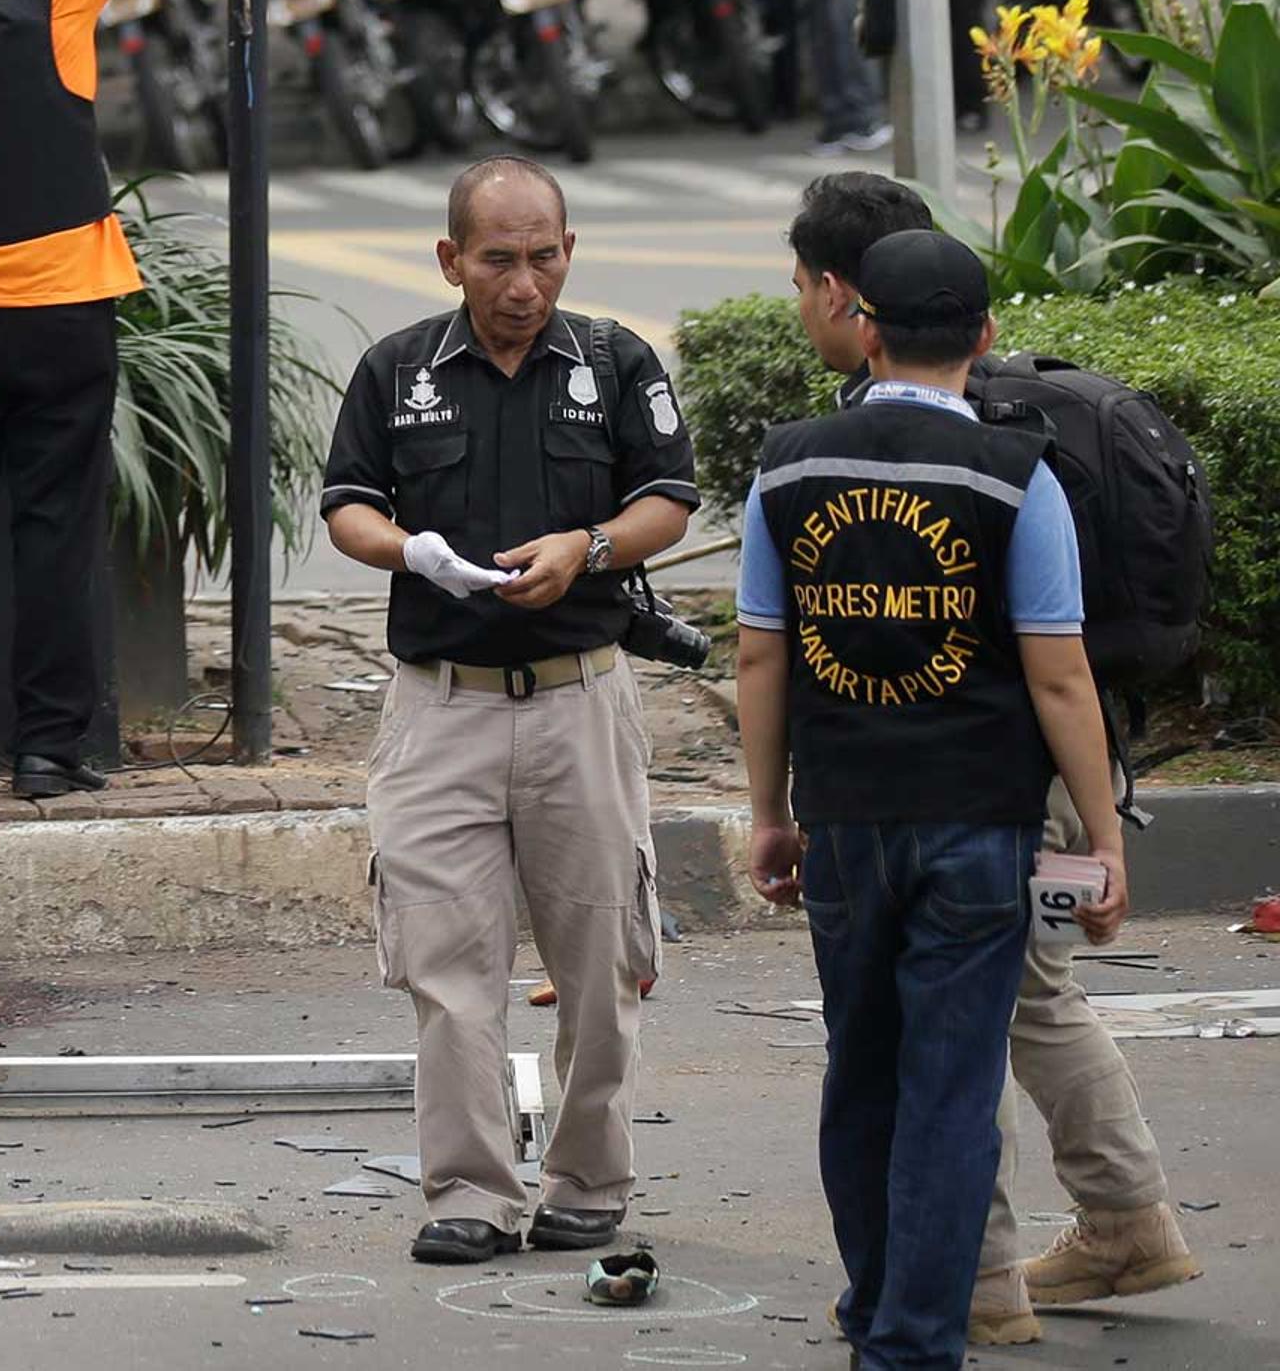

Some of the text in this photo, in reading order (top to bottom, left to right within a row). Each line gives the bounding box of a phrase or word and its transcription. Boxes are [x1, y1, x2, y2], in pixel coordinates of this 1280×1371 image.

[563, 408, 603, 423] IDENT
[790, 487, 978, 576] IDENTIFIKASI
[794, 583, 976, 620] POLRES METRO
[799, 621, 980, 705] JAKARTA PUSAT
[1039, 890, 1077, 930] 16
